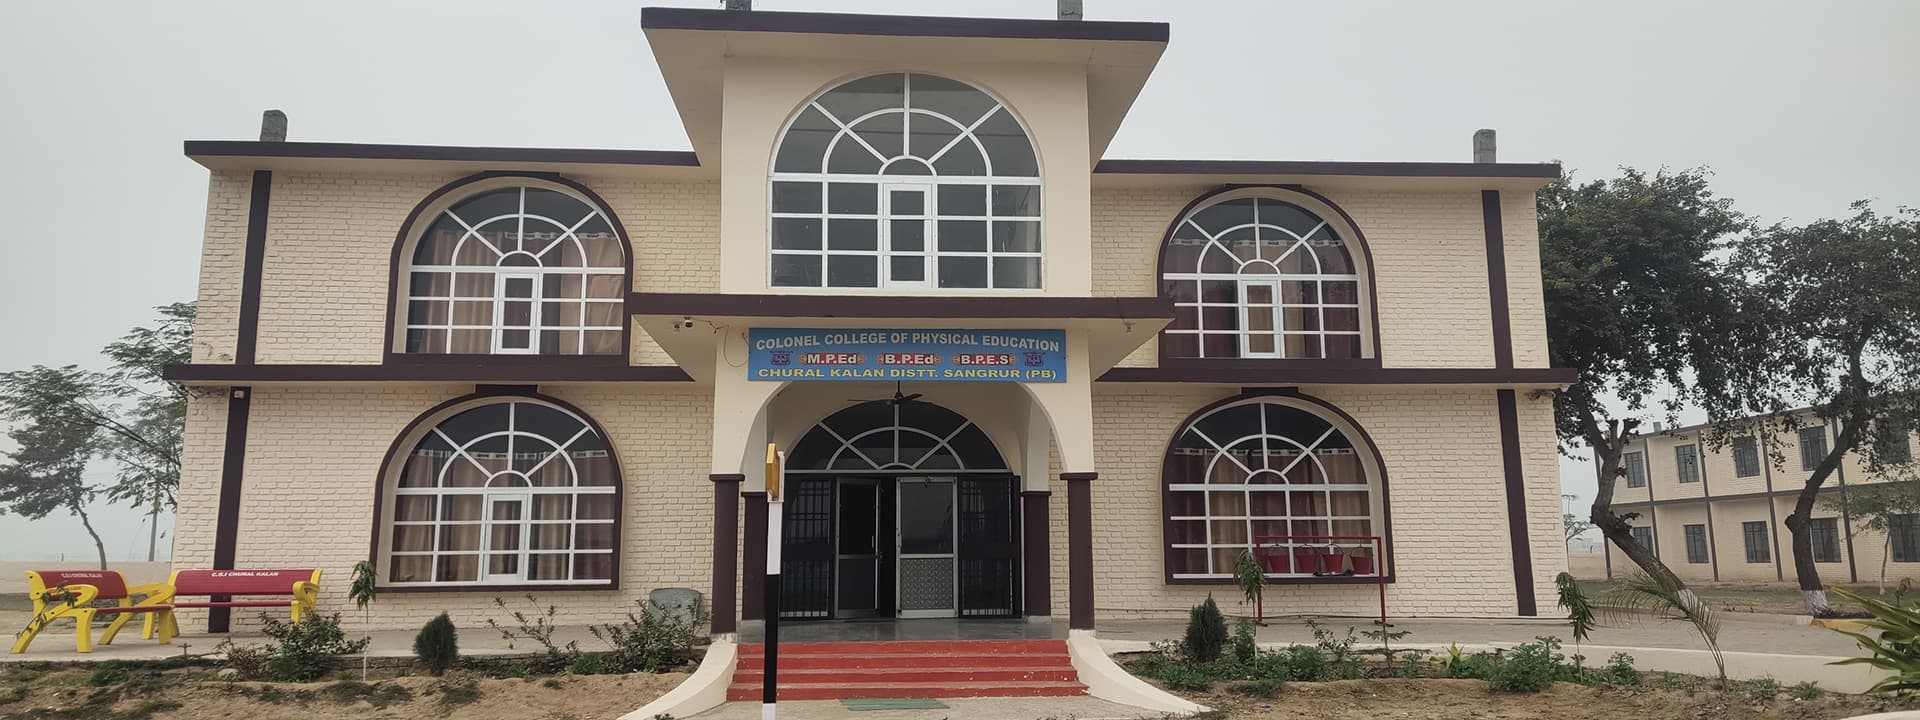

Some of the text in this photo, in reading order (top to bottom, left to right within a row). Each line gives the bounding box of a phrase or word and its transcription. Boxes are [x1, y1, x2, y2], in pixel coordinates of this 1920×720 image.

[756, 333, 1059, 352] COLONEL COLLEGE OF PHYSICAL EDUCATION
[807, 354, 857, 364] M.P.Ed
[885, 354, 933, 364] B.P.Ed
[961, 355, 1009, 364] B.P.E.S
[758, 369, 1057, 380] CHURAL KALAN DISTT. SANGRUR (PB)
